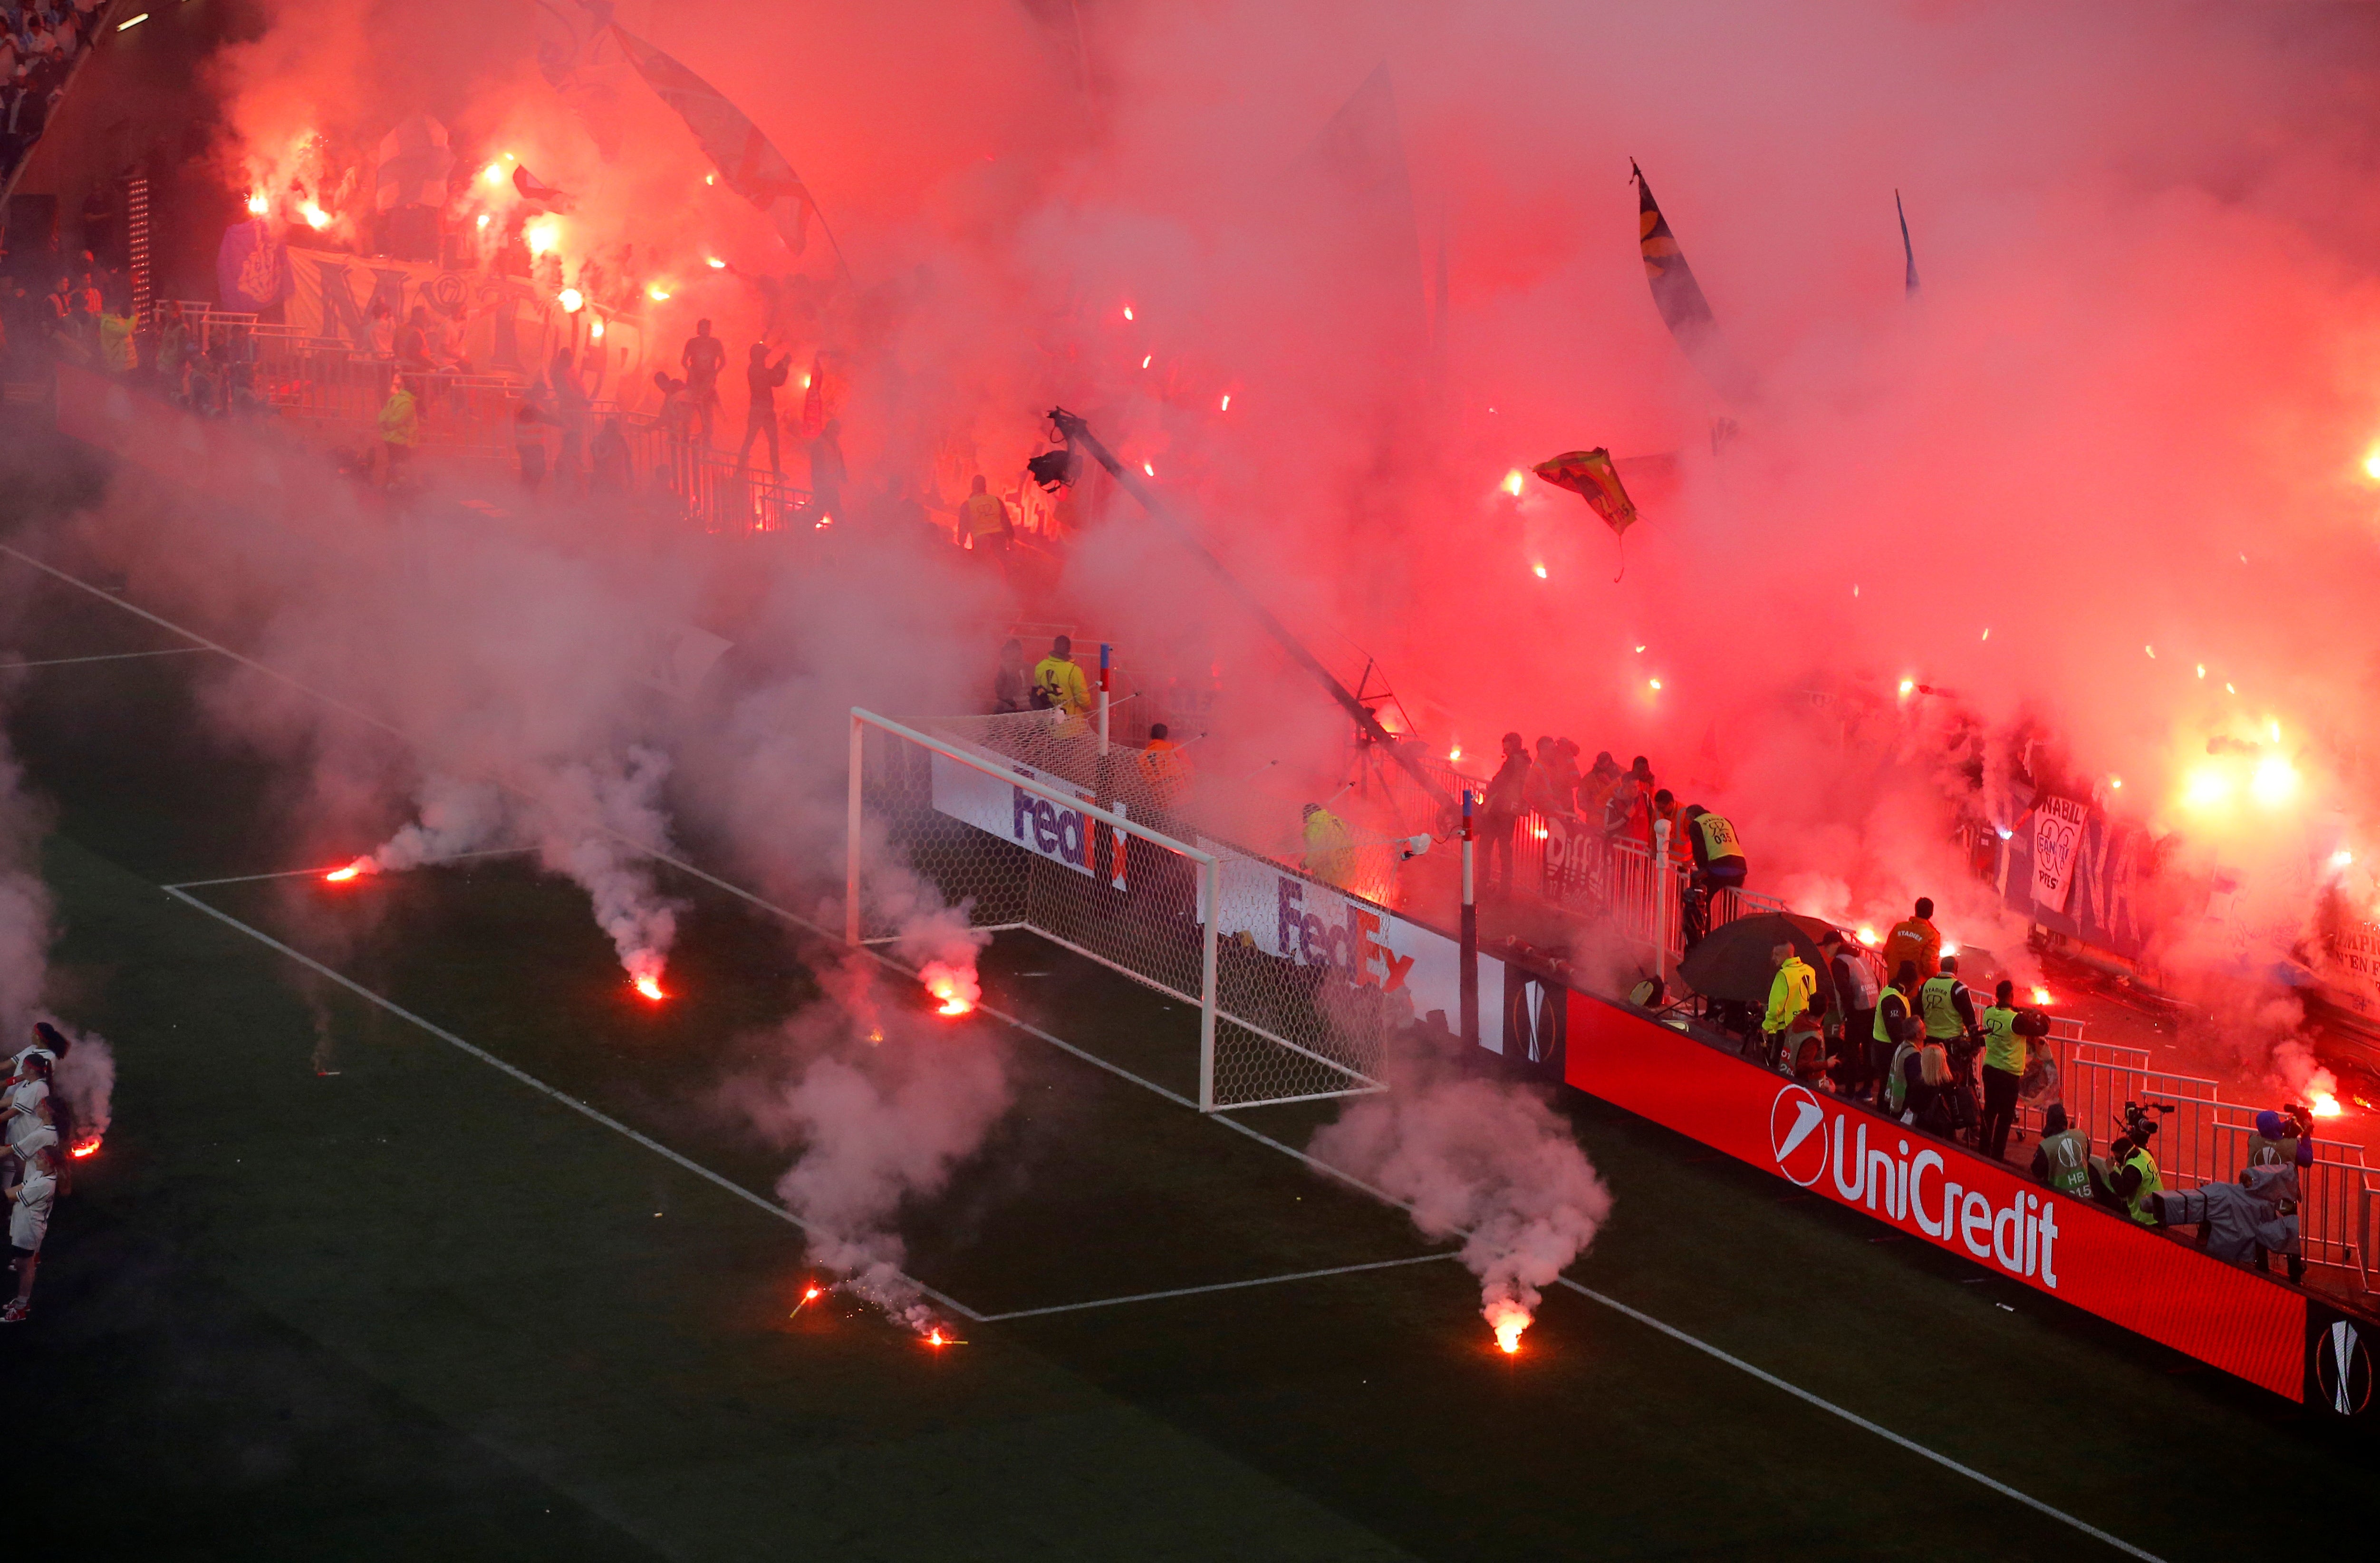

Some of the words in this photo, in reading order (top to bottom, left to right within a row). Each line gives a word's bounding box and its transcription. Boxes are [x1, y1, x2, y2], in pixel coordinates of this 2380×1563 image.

[2042, 797, 2080, 825] NABIL
[1714, 832, 1732, 844] 035
[1278, 876, 1415, 993] FedEx
[1925, 987, 1947, 996] STADIER
[2067, 1171, 2084, 1185] HB
[1833, 1114, 2058, 1289] UniCredit
